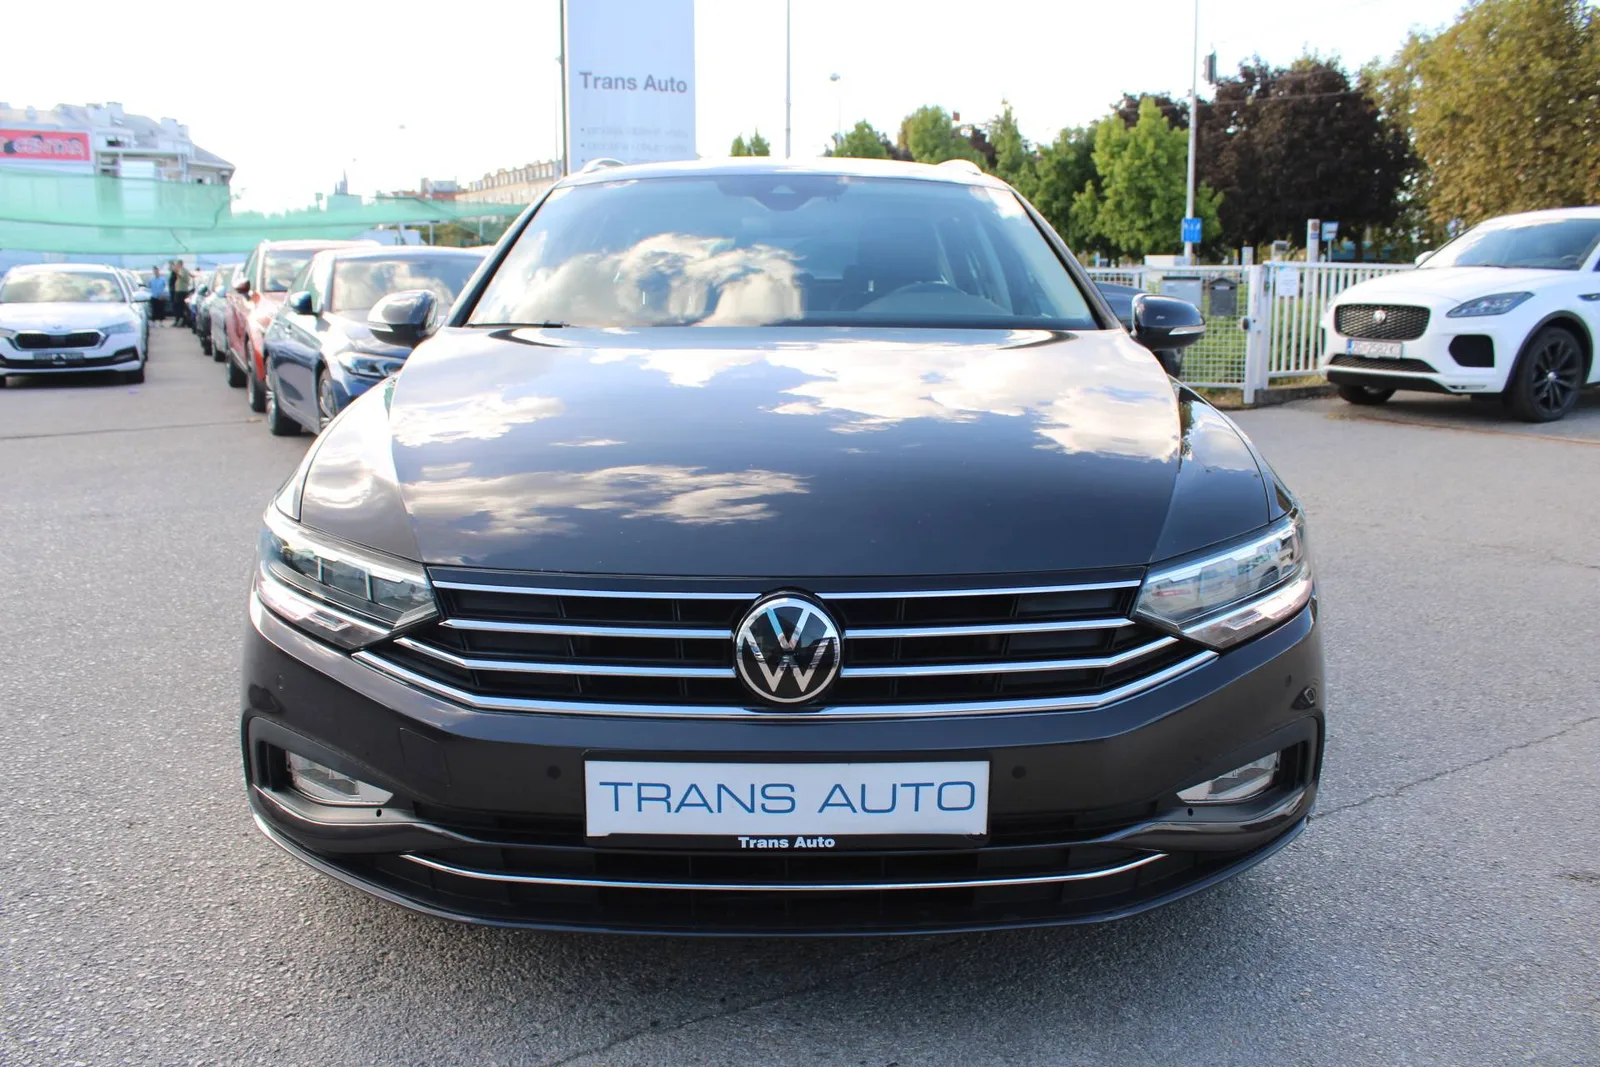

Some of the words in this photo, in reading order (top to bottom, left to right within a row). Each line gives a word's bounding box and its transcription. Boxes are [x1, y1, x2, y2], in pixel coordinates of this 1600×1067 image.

[578, 71, 638, 91] Trans
[643, 74, 688, 94] Auto
[599, 781, 796, 814] TRANS
[817, 781, 976, 814] AUTO
[738, 836, 789, 849] Trans
[793, 836, 836, 849] Auto
